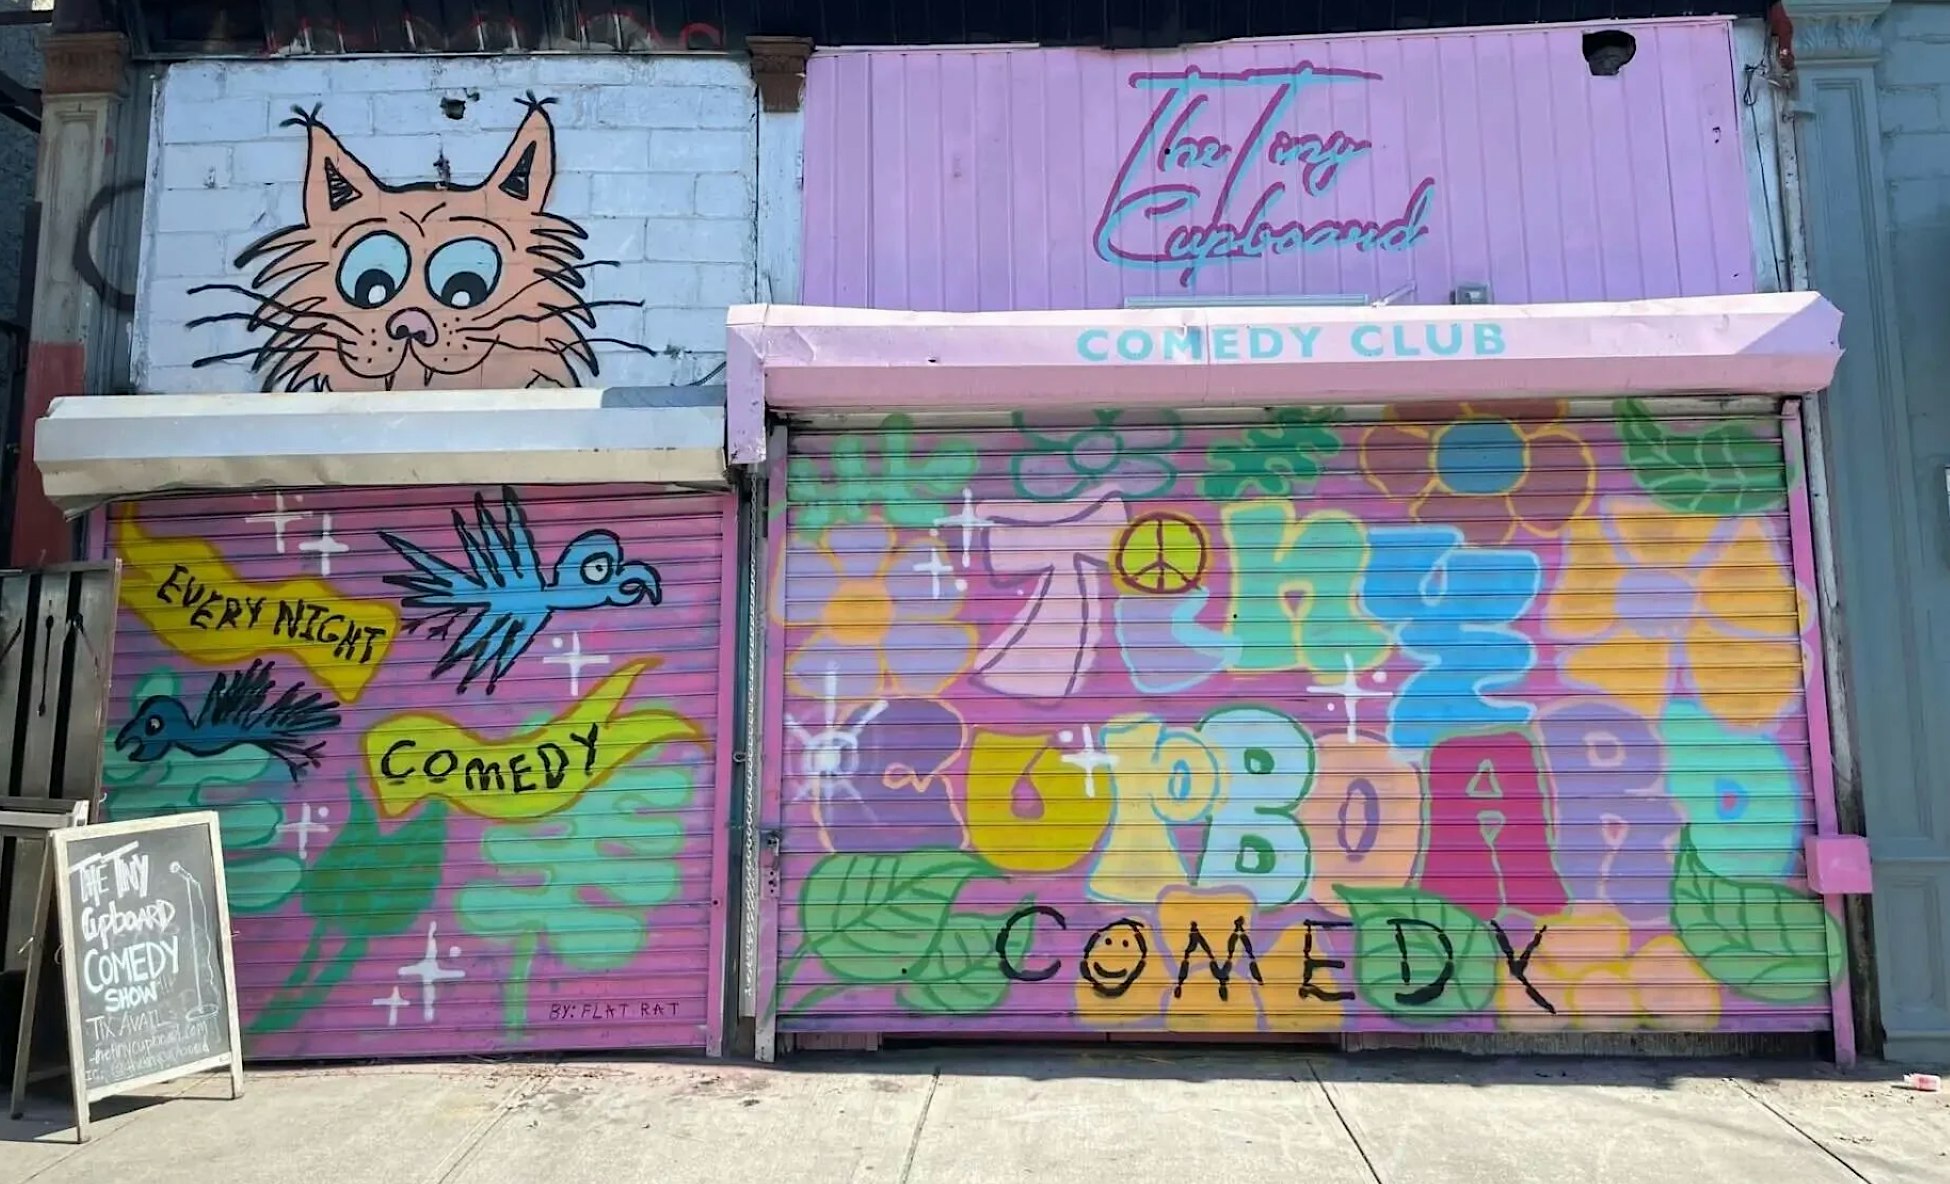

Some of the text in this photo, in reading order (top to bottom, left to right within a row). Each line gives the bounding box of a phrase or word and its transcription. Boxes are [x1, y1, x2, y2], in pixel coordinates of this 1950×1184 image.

[1076, 322, 1507, 363] COMEDY CLUB
[157, 564, 387, 664] EVERY NIGHT
[379, 722, 601, 794] COMEDY
[83, 935, 179, 994] COMEDY
[104, 981, 158, 1012] SHOW
[550, 1002, 680, 1020] BY: FLAT RAT
